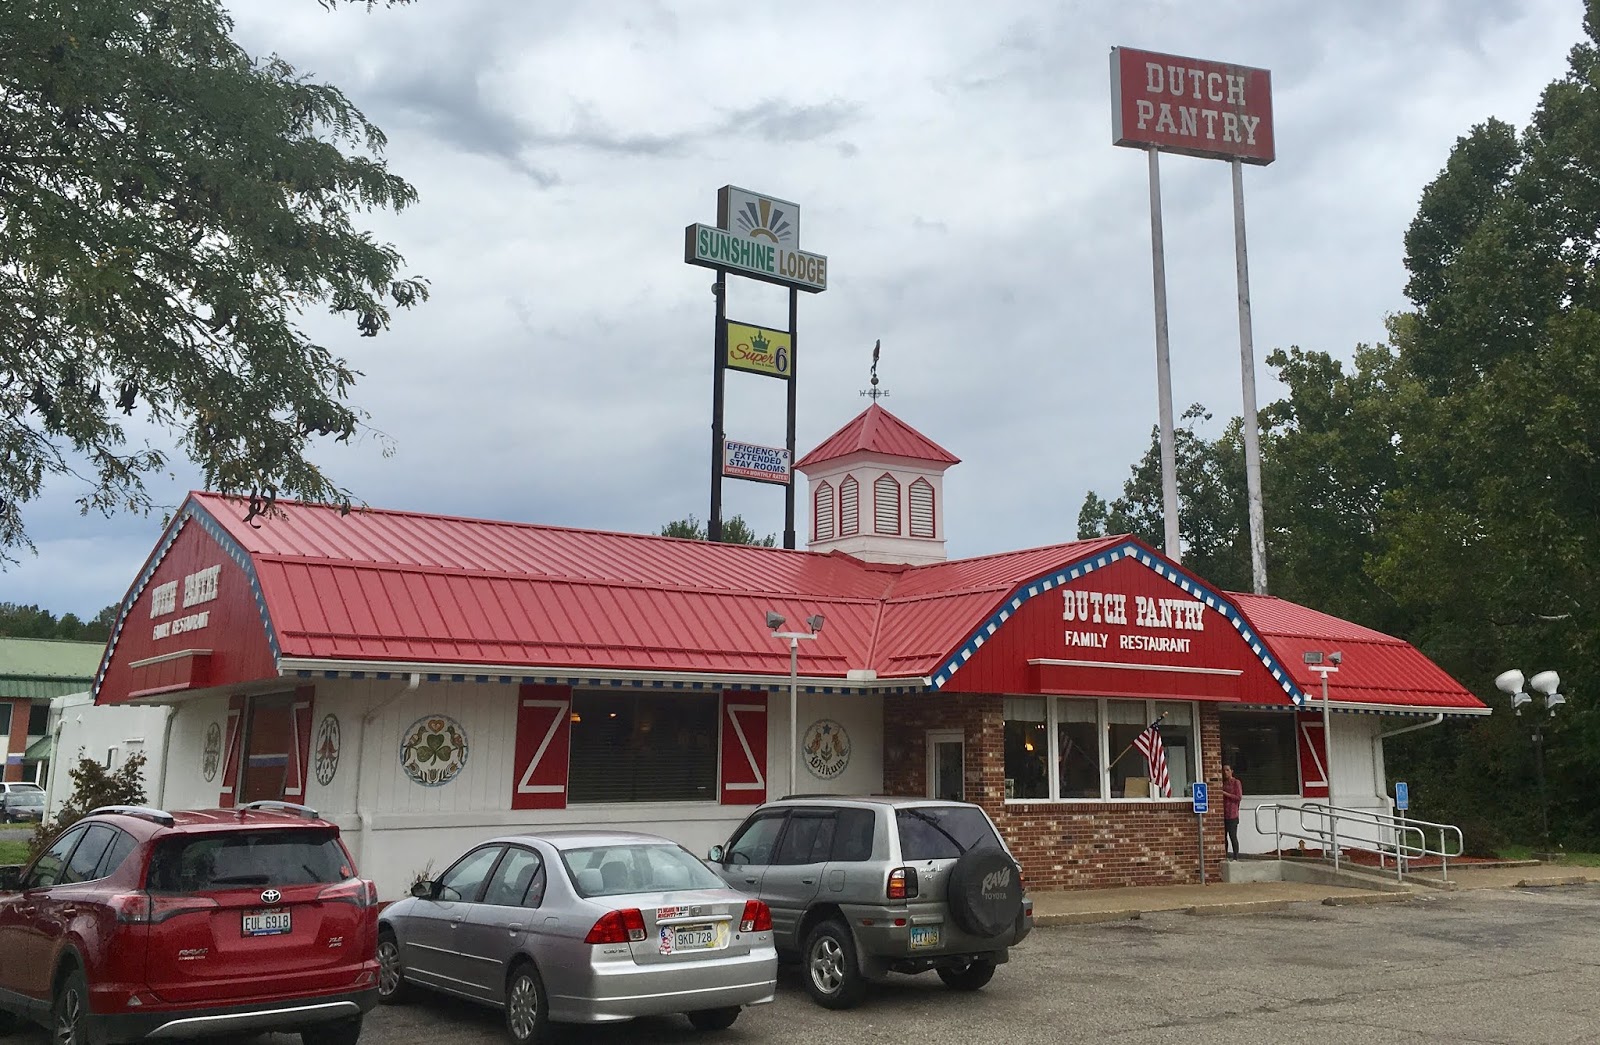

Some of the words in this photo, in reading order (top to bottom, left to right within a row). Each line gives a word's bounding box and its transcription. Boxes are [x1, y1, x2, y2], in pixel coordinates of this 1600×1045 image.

[1145, 62, 1246, 106] DUTCH
[1136, 99, 1260, 145] PANTRY
[699, 229, 775, 272] SUNSHINE
[779, 249, 825, 285] LODGE
[730, 343, 774, 366] Super
[775, 347, 788, 372] 6
[727, 442, 780, 458] EFFICIENCY
[782, 451, 789, 459] &
[734, 451, 782, 465] EXTENDED
[729, 458, 752, 468] STAY
[754, 462, 786, 473] ROOMS
[1062, 589, 1128, 625] DUTCH
[1134, 595, 1206, 631] PANTRY
[1065, 630, 1109, 649] FAMILY
[1119, 634, 1191, 653] RESTAURANT
[981, 866, 1010, 896] RAV4
[984, 892, 1007, 900] TOYOTA
[245, 917, 262, 931] EUL
[265, 914, 289, 929] 6918
[697, 931, 712, 944] 728
